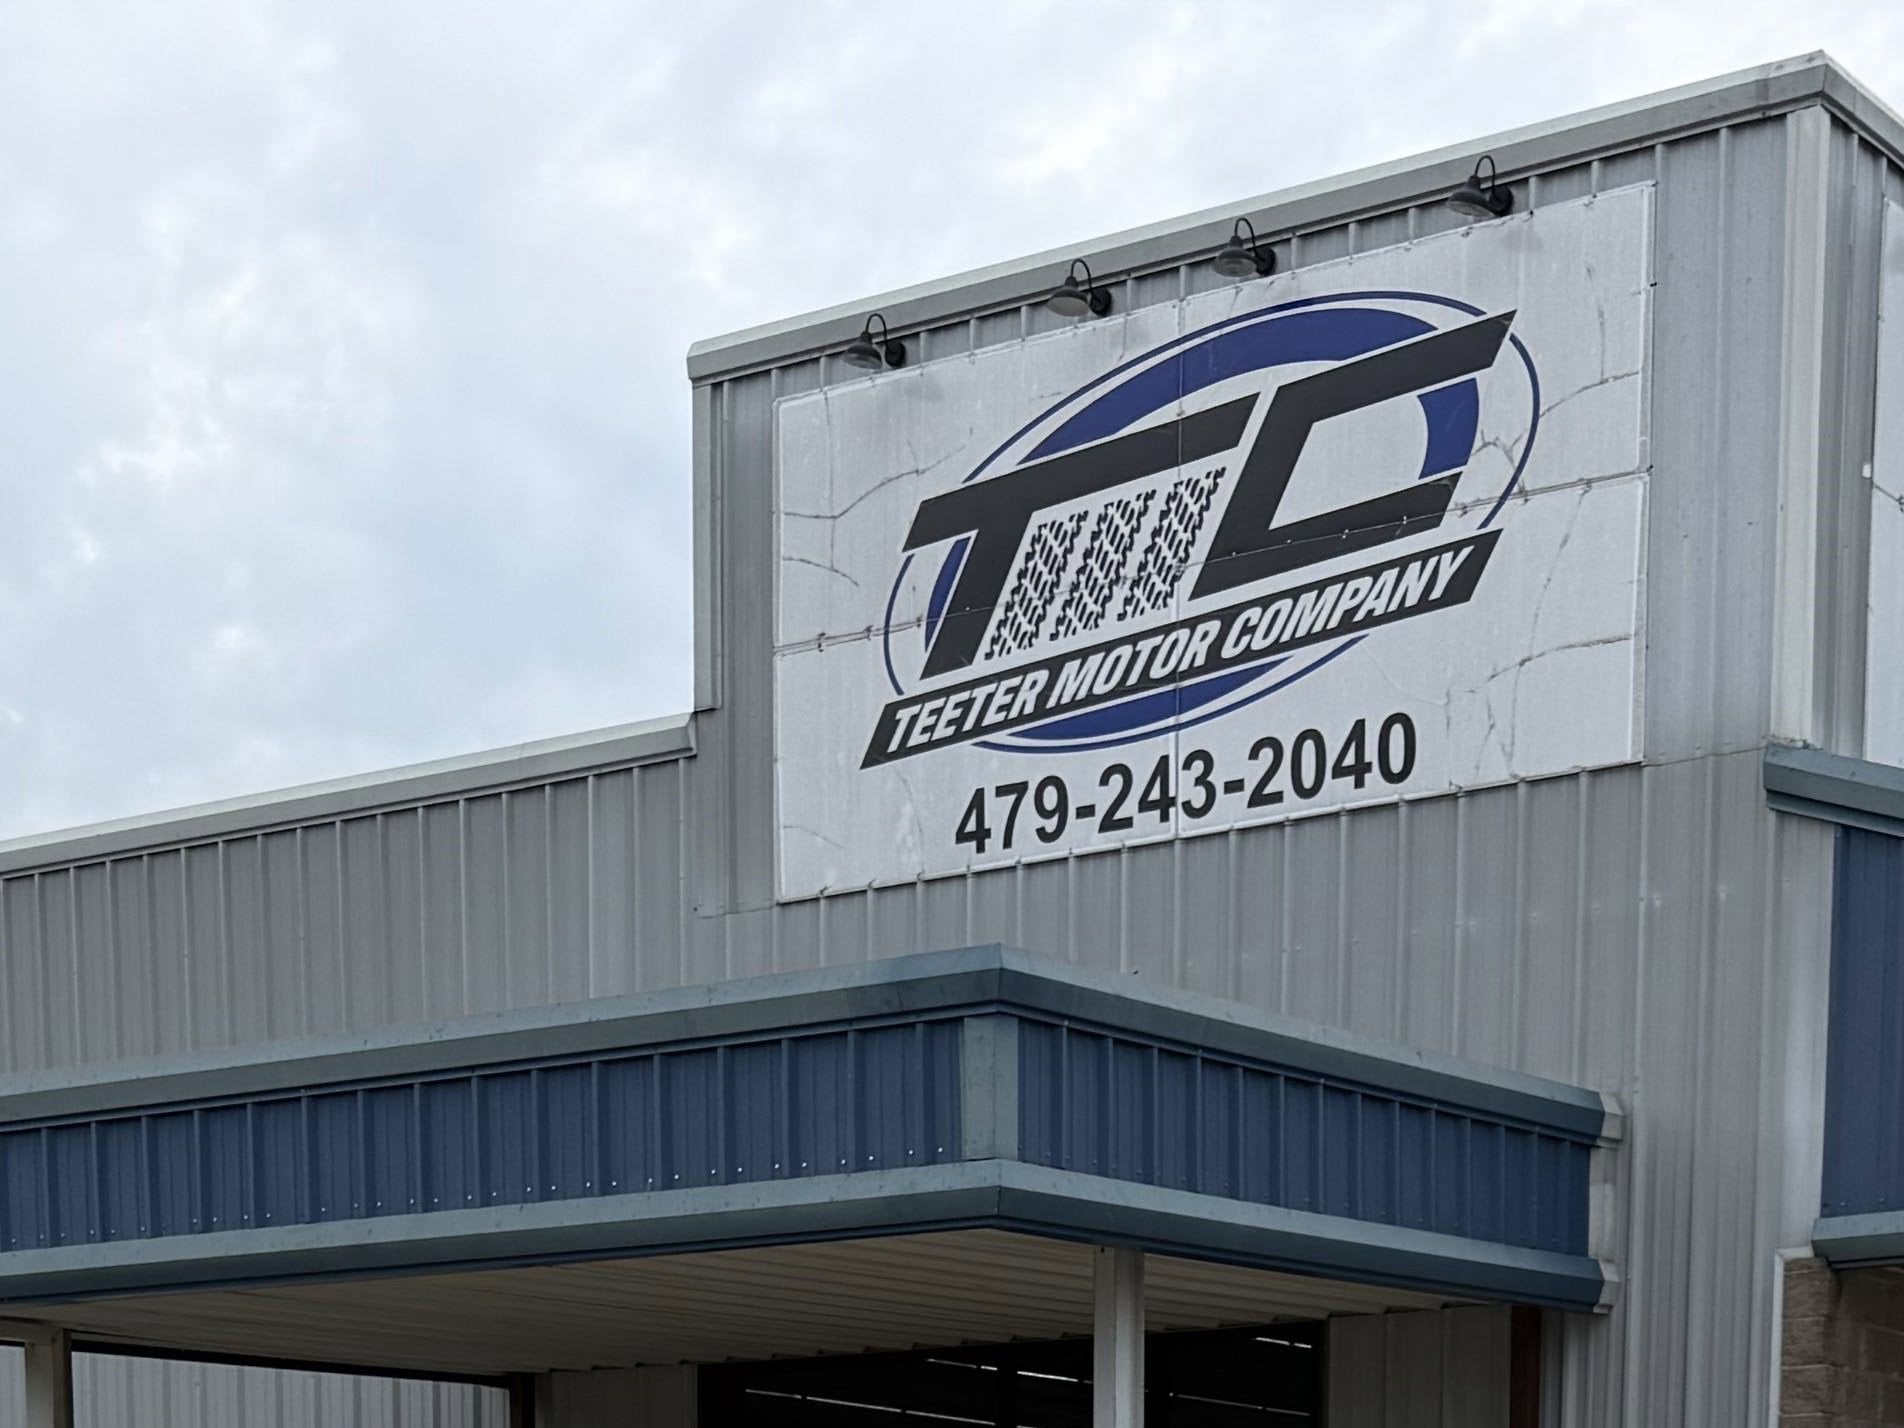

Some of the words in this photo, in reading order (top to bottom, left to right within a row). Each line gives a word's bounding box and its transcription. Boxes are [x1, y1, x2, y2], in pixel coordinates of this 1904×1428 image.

[887, 672, 1055, 754] TEETER
[1049, 625, 1214, 708] MOTOR
[1222, 544, 1477, 654] COMPANY
[954, 712, 1419, 855] 479-243-2040
